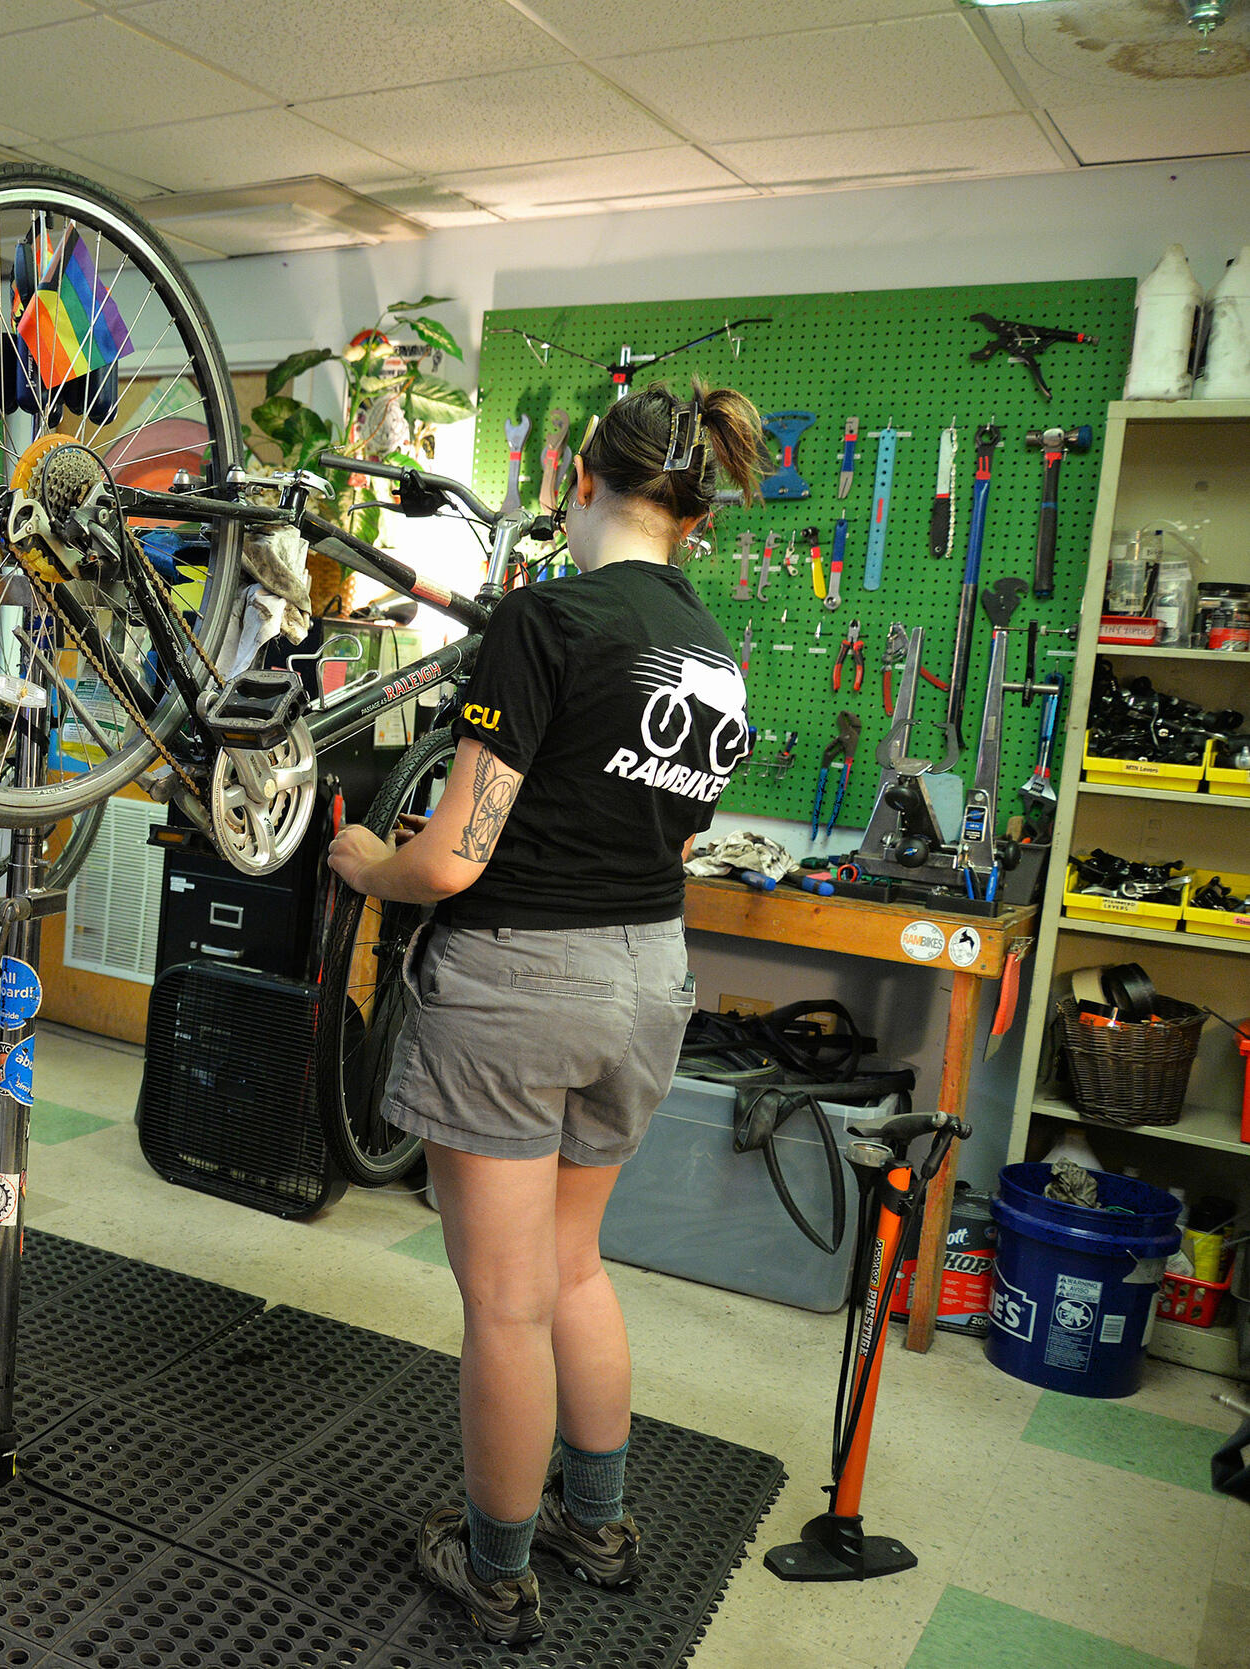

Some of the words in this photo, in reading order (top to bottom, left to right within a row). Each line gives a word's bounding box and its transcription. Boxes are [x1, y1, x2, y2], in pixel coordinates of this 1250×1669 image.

[382, 661, 442, 701] RALEIGH
[361, 702, 381, 715] PASSAGE
[461, 702, 502, 732] CU.
[903, 933, 944, 950] RAMBIKES
[2, 971, 16, 985] All
[946, 1227, 968, 1246] ott
[943, 1251, 993, 1276] HOP
[1067, 1278, 1098, 1289] WARNING
[859, 1287, 878, 1357] PRESTIGE
